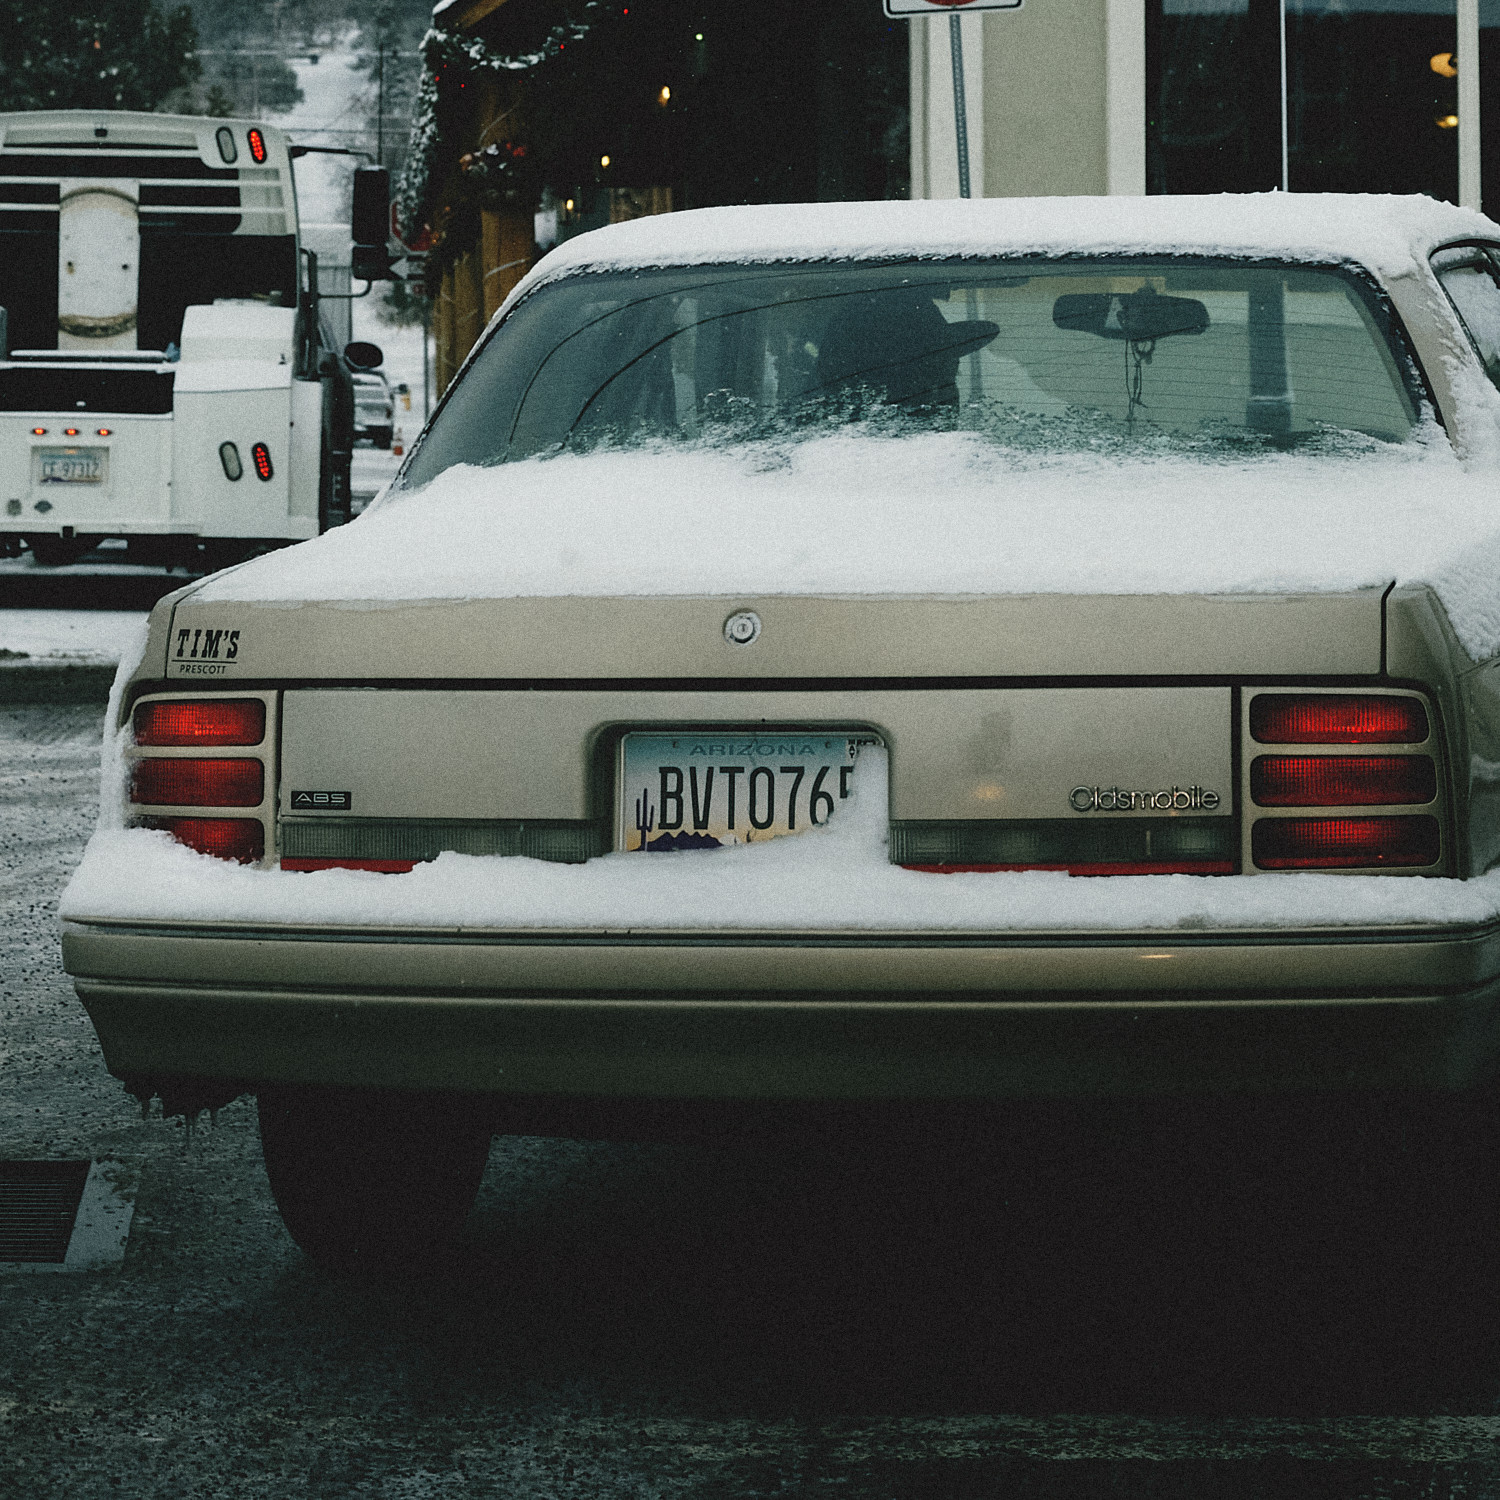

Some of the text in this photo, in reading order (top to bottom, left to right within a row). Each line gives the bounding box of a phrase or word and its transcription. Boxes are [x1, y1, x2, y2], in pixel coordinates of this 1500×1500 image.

[176, 628, 241, 659] TIM'S
[179, 664, 226, 674] PRESCOTT
[688, 743, 816, 757] ARIZONA
[295, 792, 346, 803] ABS
[1069, 785, 1220, 811] Oldsmobile
